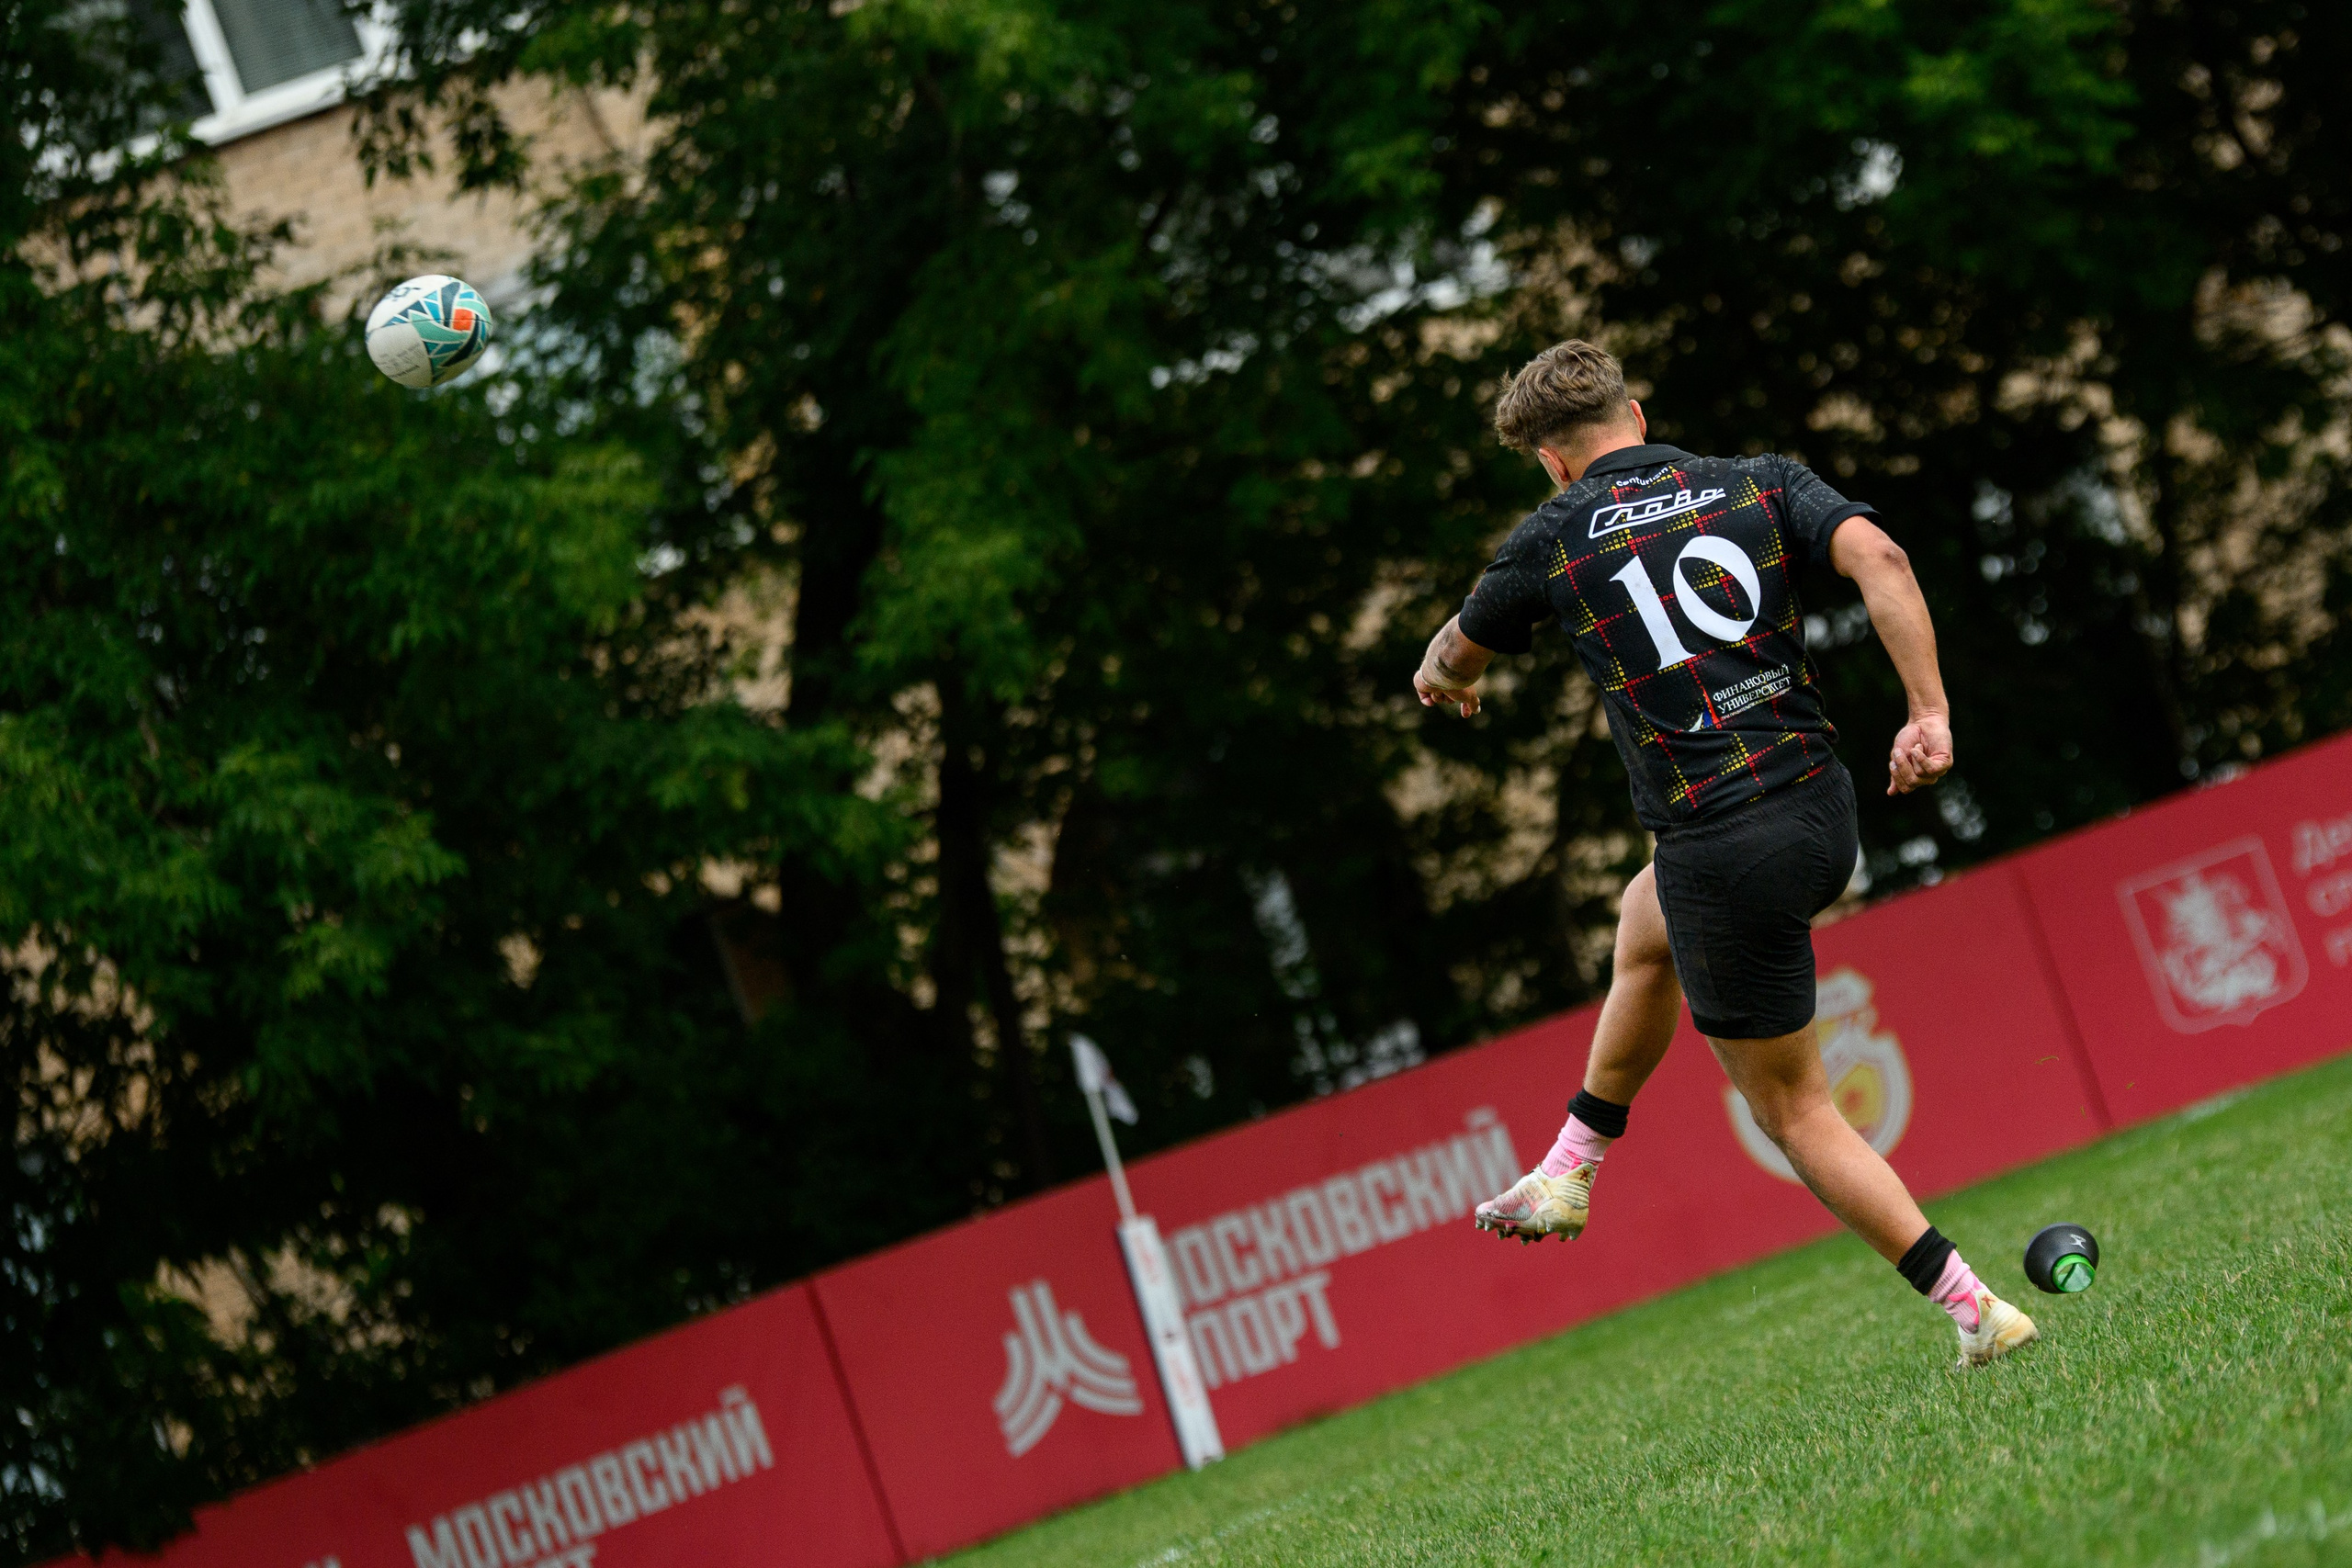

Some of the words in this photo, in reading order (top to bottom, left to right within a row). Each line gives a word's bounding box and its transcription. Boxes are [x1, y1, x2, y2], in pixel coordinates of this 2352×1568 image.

[1610, 536, 1761, 670] 10
[1713, 663, 1790, 702] ФИНАНСОВЫЙ
[1167, 1106, 1527, 1309] ОСКОВСКИЙ
[1188, 1269, 1341, 1391] ПОРТ
[404, 1384, 774, 1567] МОСКОВСКИЙ
